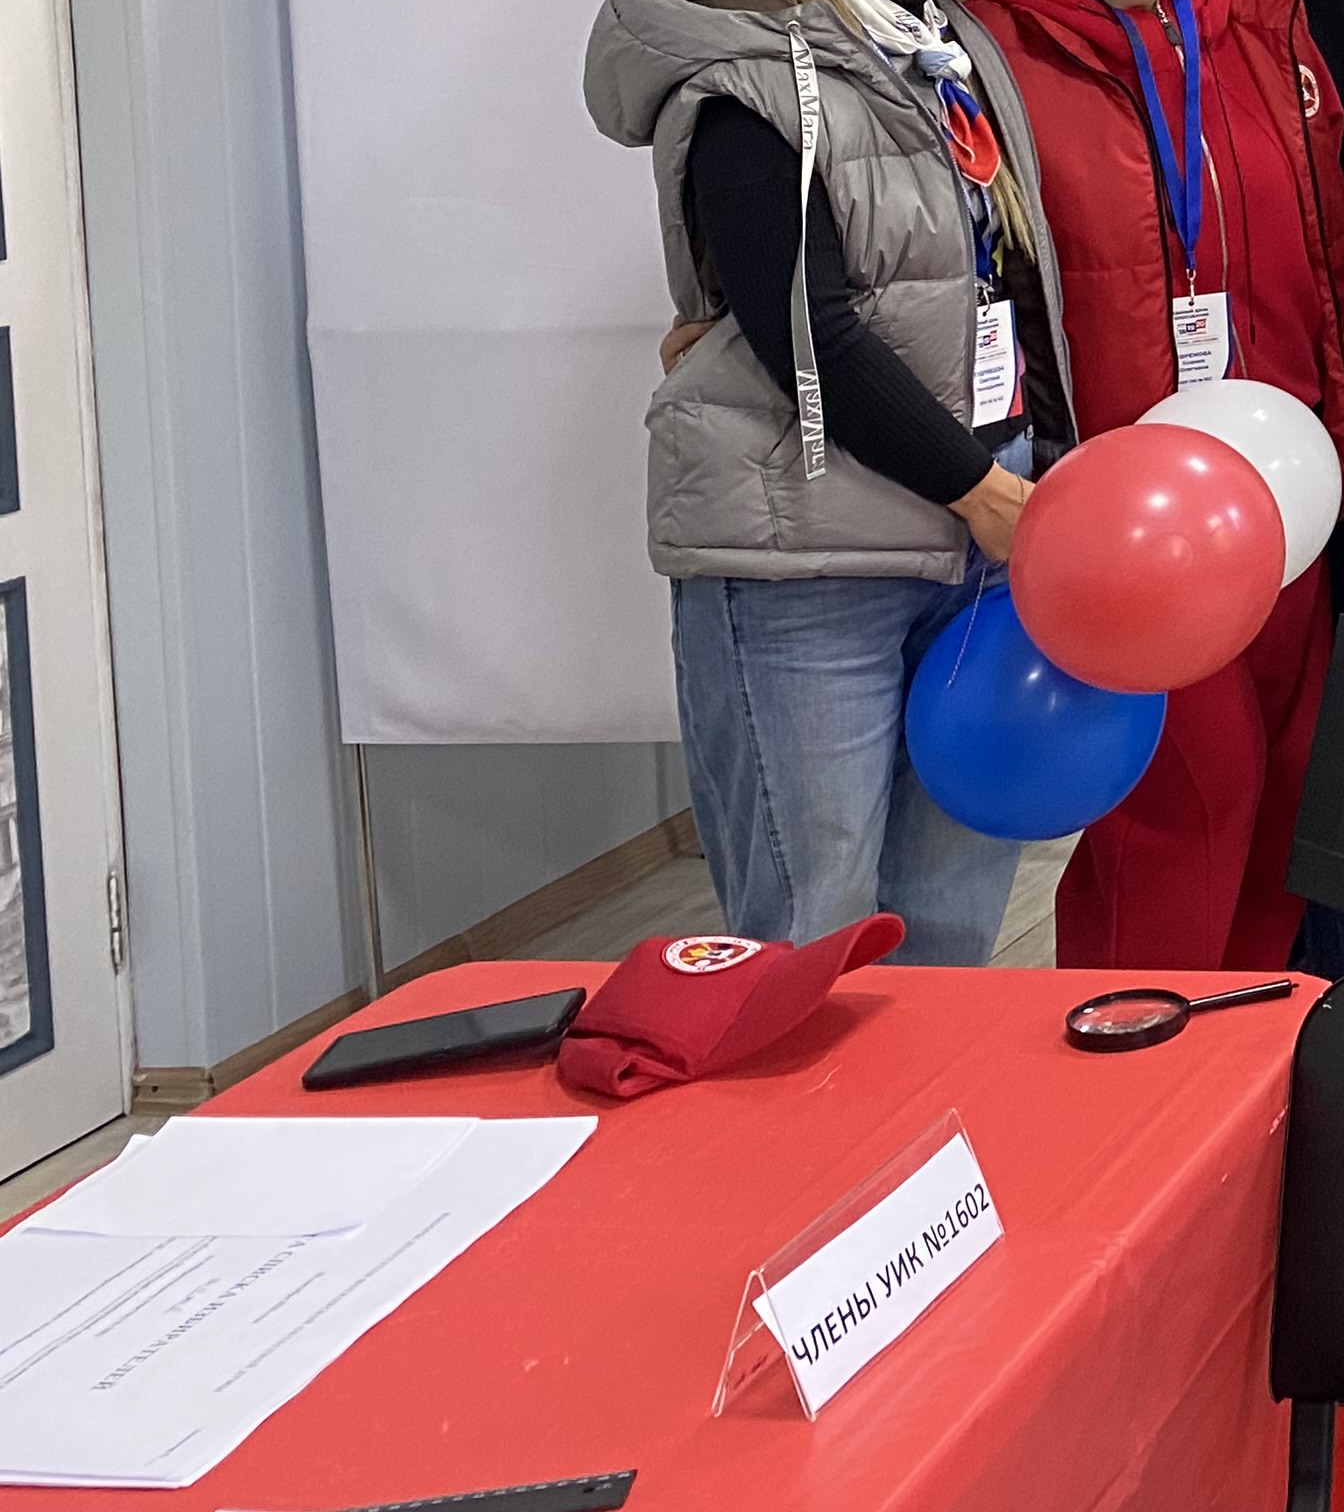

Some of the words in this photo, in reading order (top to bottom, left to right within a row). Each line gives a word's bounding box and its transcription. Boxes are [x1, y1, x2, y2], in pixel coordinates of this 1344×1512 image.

[793, 48, 820, 151] MaxMara
[217, 1251, 293, 1300] СПИСКА
[791, 1282, 878, 1366] ЧЛЕНЫ
[876, 1241, 925, 1298] УИК
[921, 1183, 990, 1259] №1602
[89, 1301, 225, 1391] ИЗБИРАТЕЛЕЙ
